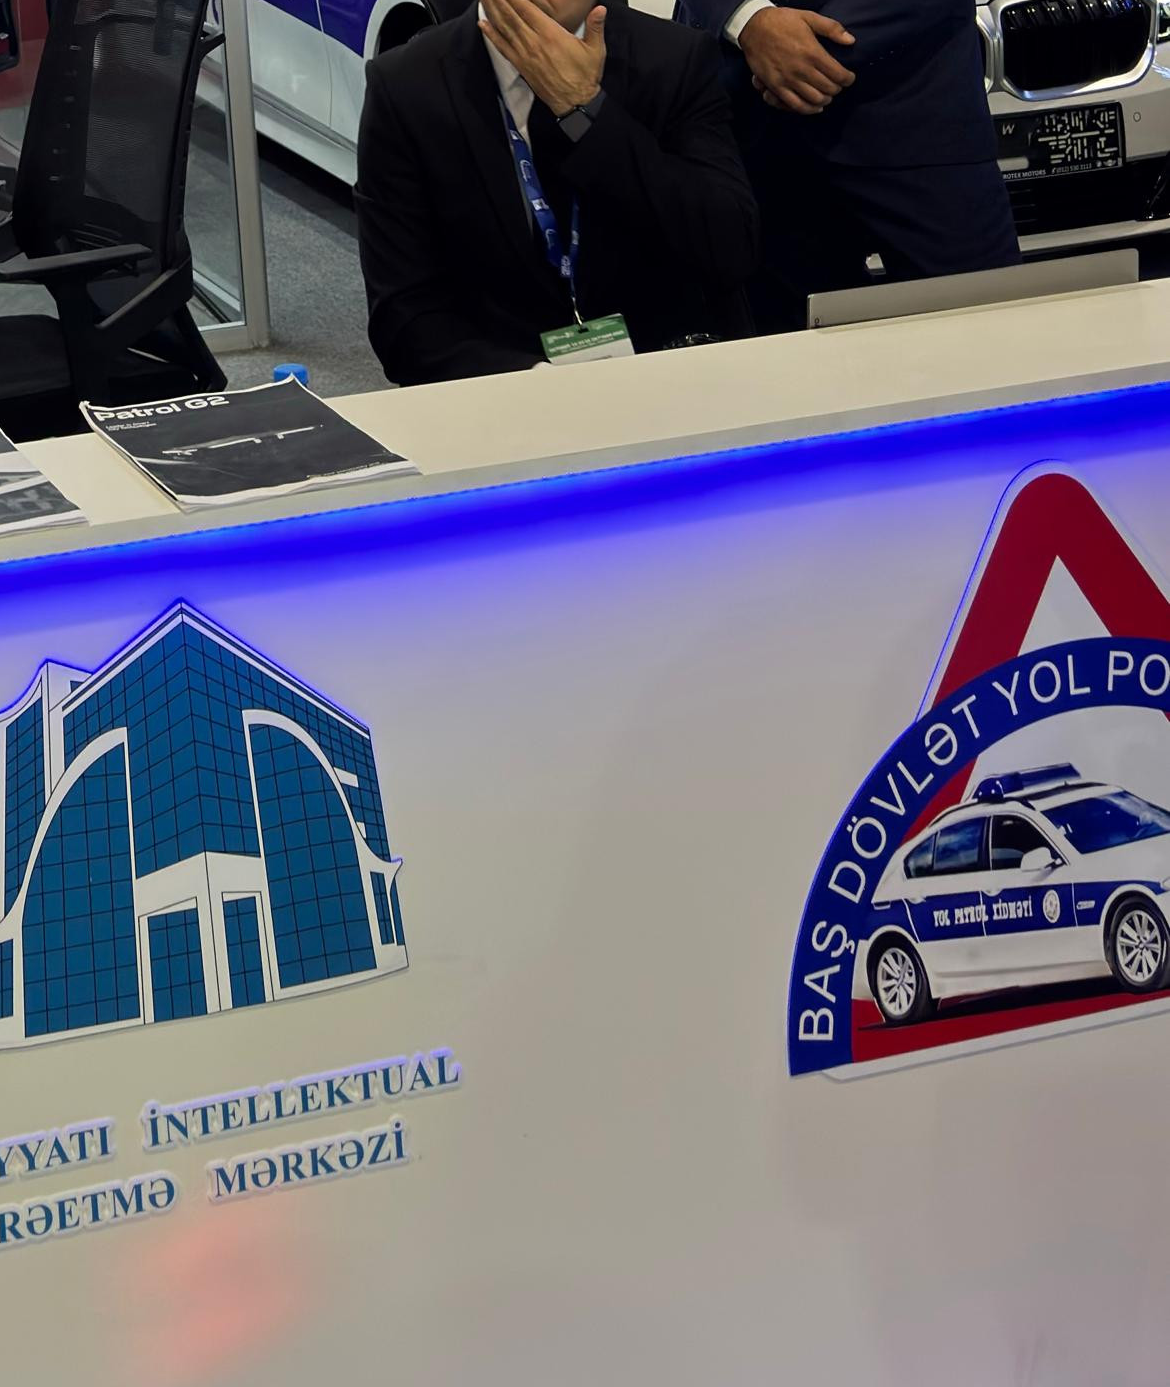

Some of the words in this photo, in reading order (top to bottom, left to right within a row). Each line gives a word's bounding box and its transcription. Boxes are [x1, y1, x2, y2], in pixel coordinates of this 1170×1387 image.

[94, 404, 181, 423] Patrol
[185, 396, 230, 410] G2
[798, 921, 856, 1041] BAŞ
[828, 695, 983, 904] DÖVLƏT
[992, 652, 1091, 717] YOL
[147, 1054, 460, 1148] İNTELLEKTUAL
[214, 1121, 407, 1198] MƏRKƏZİ
